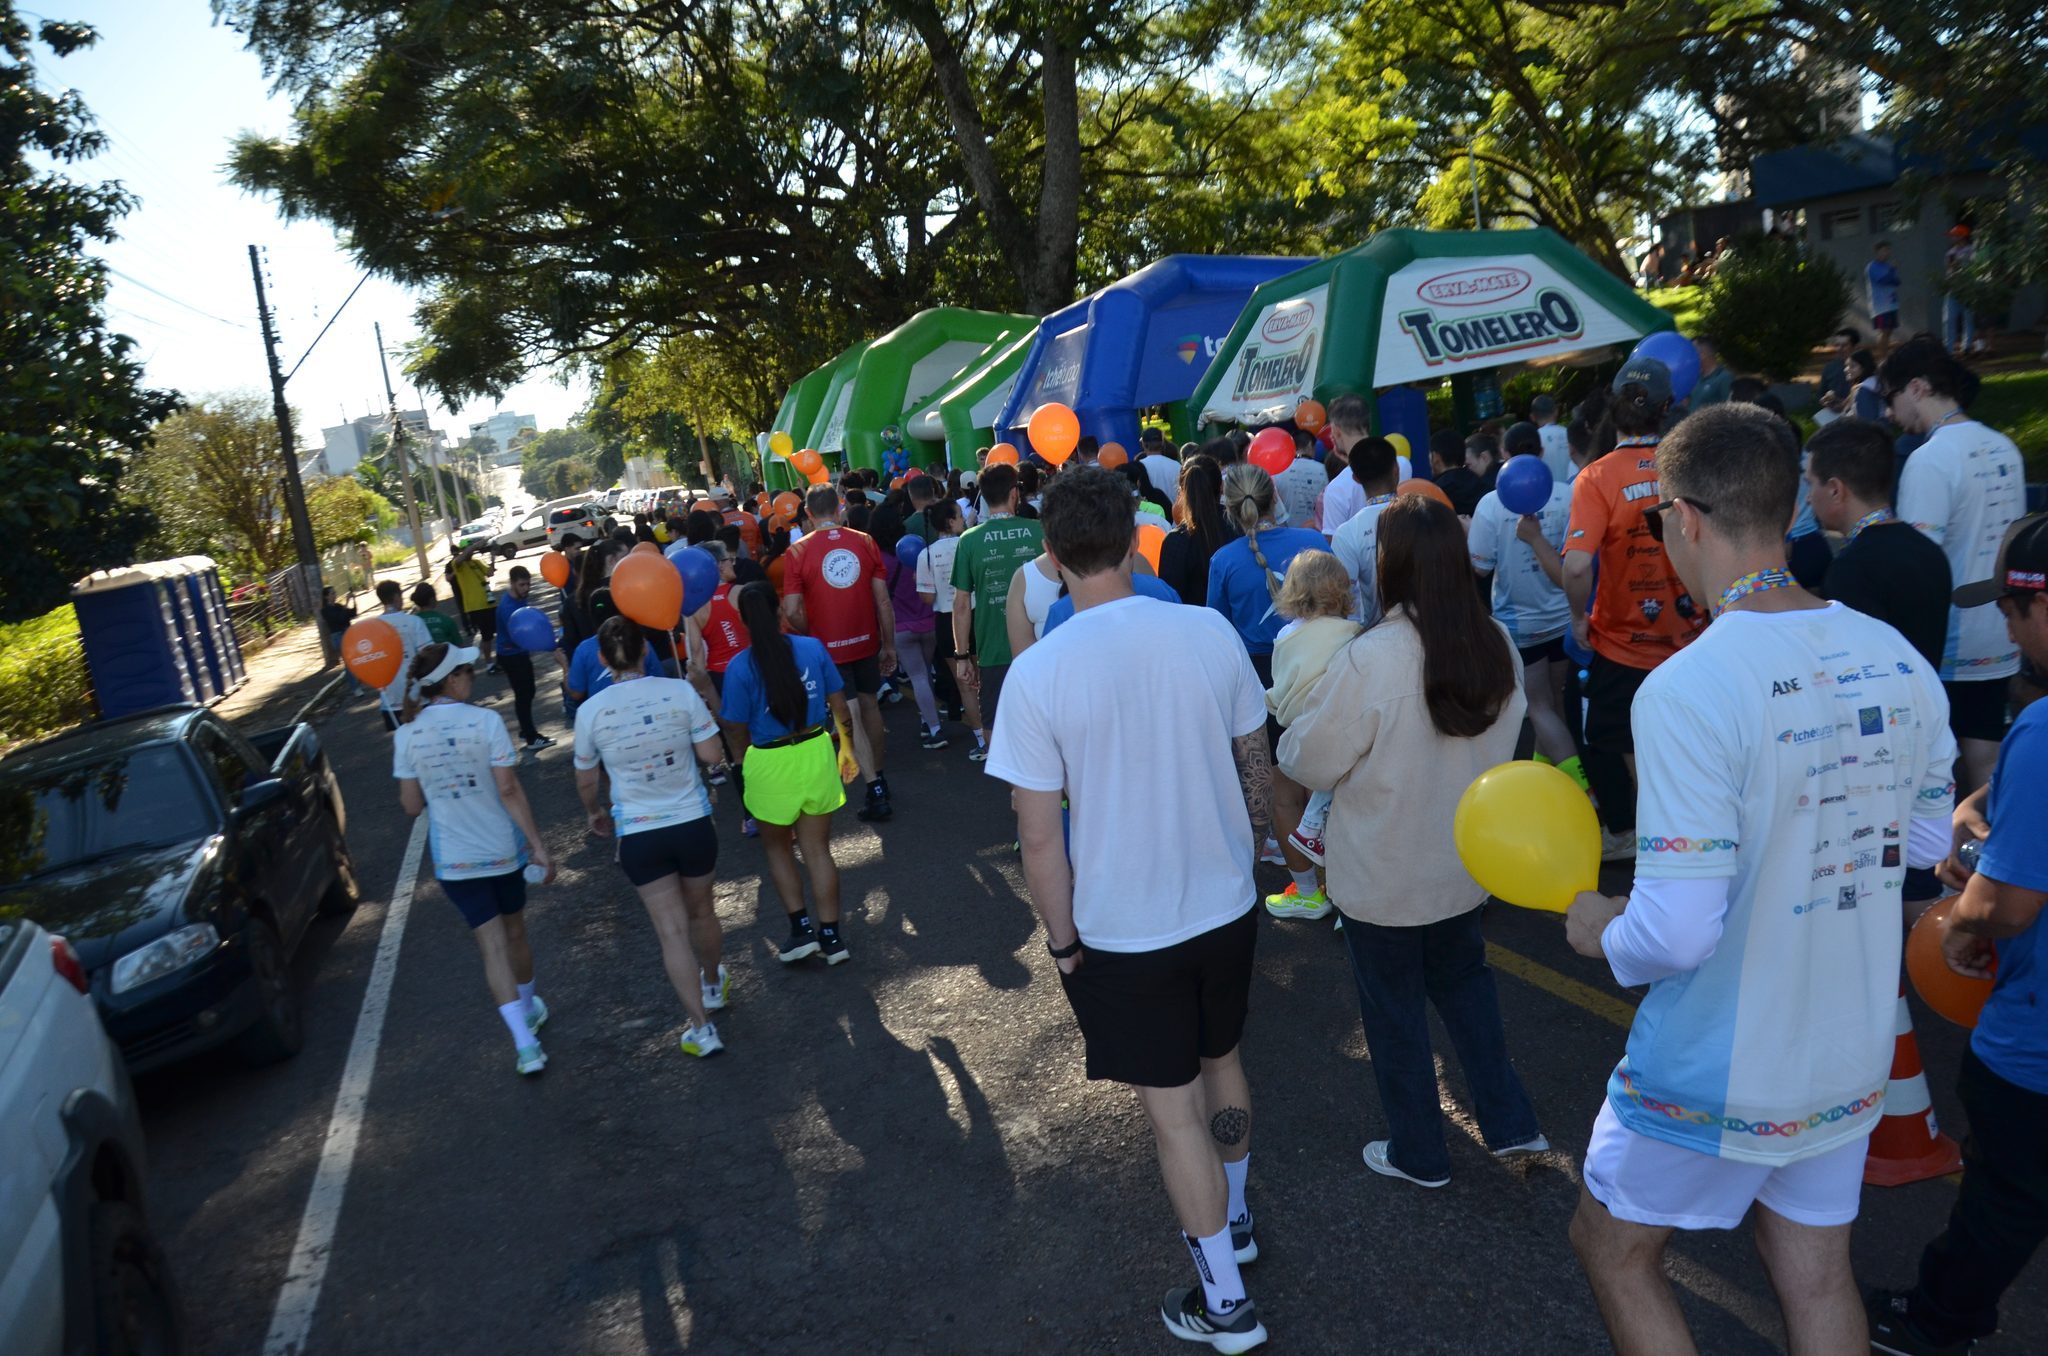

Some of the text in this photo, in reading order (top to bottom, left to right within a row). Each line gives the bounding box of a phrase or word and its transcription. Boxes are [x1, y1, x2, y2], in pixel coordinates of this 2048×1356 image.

[1428, 271, 1521, 299] ERVA-MATE
[1265, 309, 1311, 334] ERVA-MATE
[1402, 289, 1581, 362] TOMELERO
[1234, 330, 1316, 398] TOMELERO
[983, 527, 1032, 543] ATLETA
